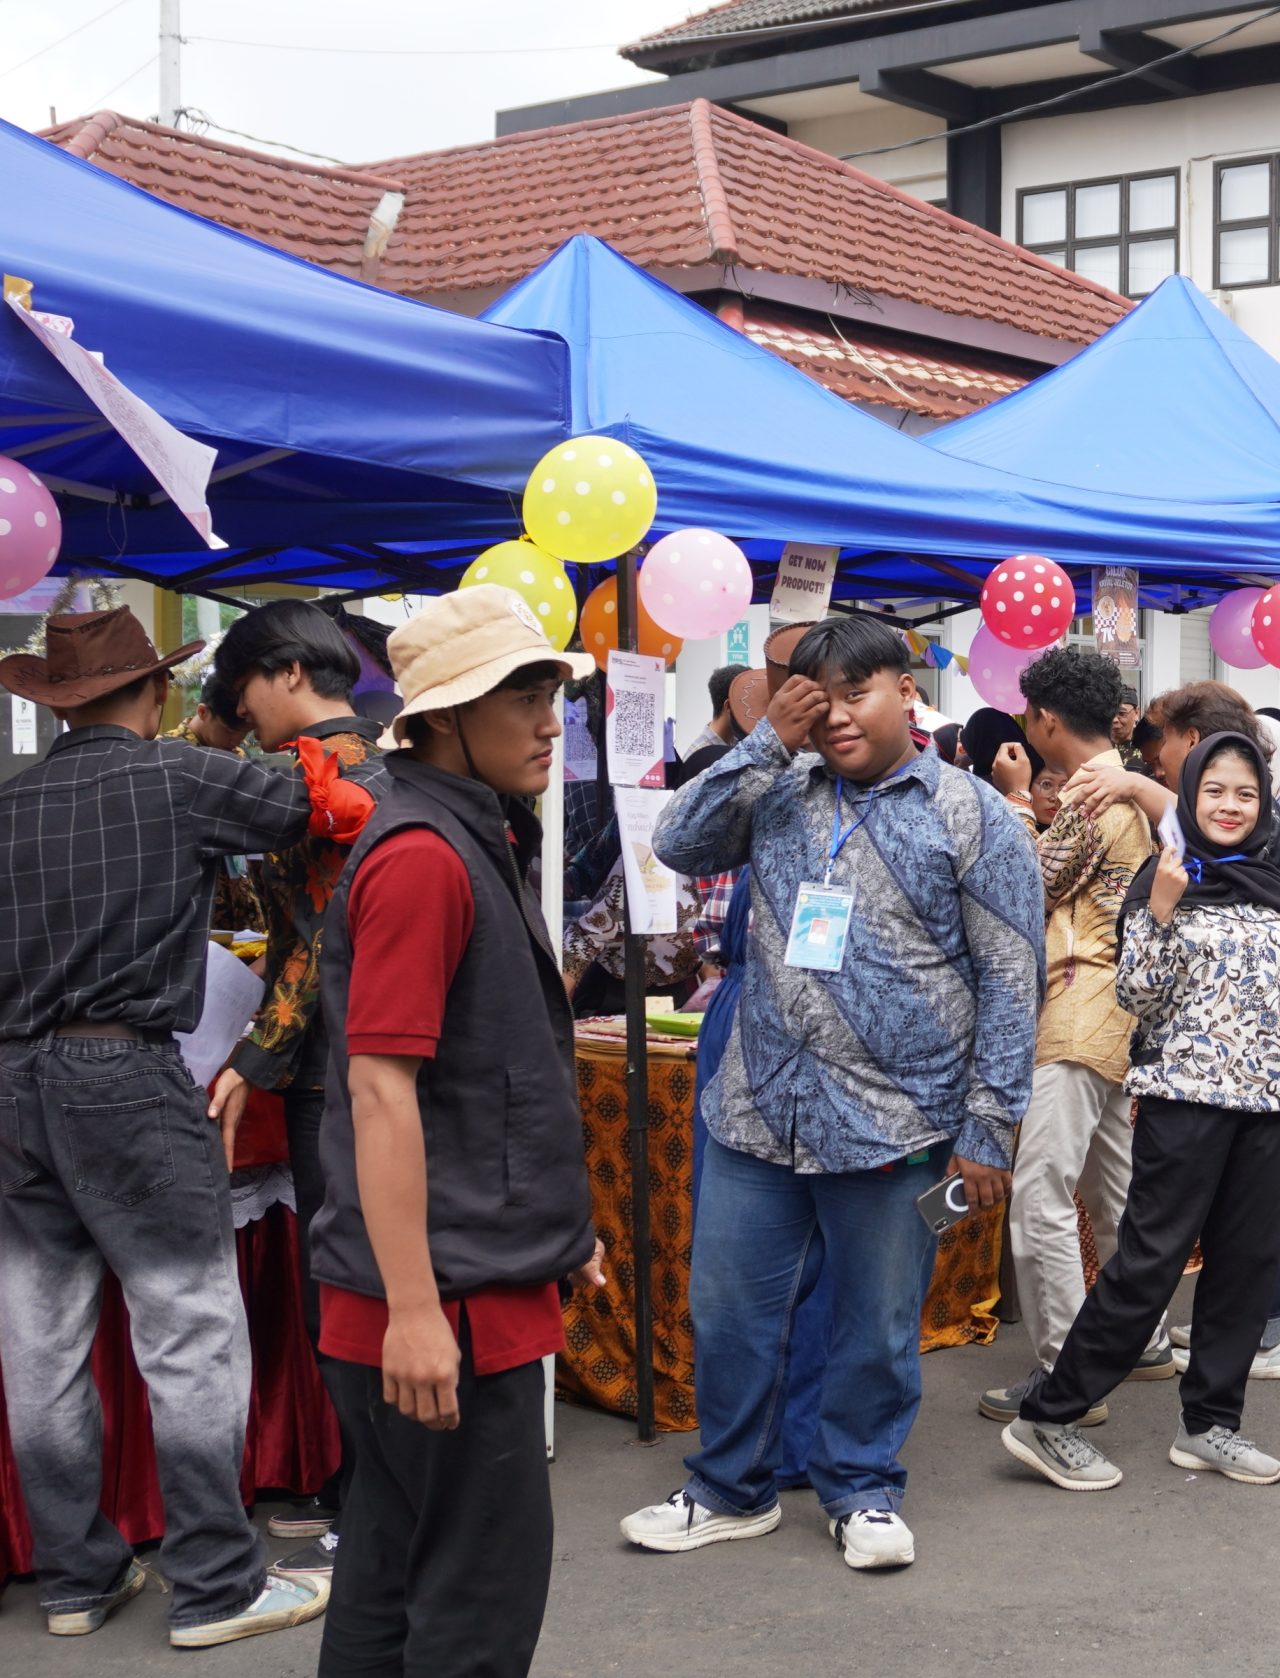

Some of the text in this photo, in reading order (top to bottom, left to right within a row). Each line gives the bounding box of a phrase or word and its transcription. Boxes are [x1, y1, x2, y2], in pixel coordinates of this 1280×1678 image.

[788, 554, 827, 572] GET NOW
[781, 575, 825, 595] PRODUCT!!
